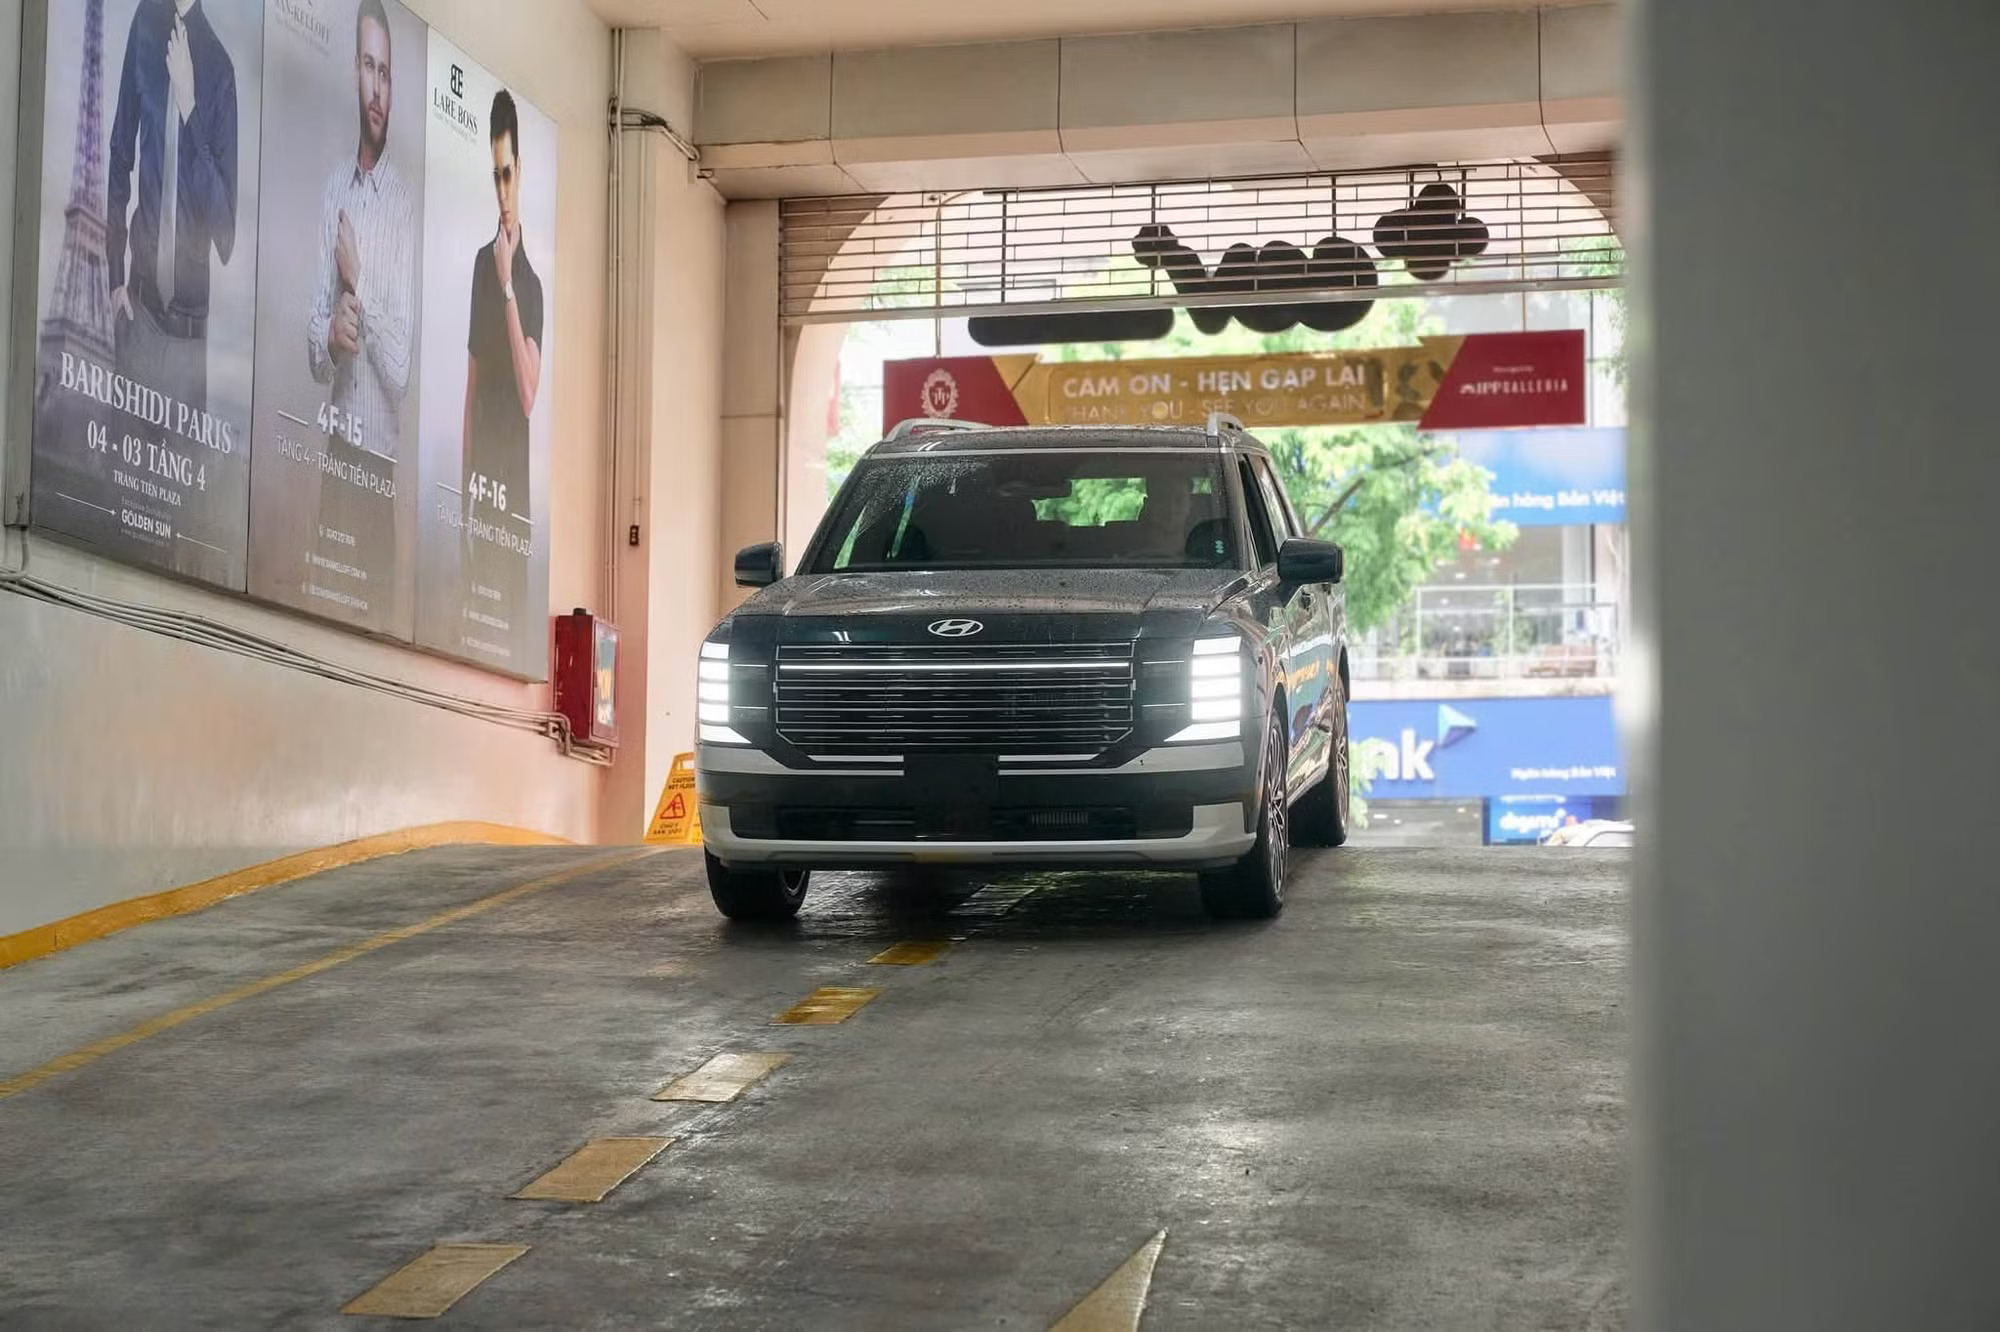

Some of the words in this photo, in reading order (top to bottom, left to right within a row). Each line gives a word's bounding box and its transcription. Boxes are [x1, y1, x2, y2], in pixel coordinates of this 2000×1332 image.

[458, 105, 478, 136] BOSS
[1325, 364, 1365, 390] LẠI
[60, 351, 172, 430] BARISHIDI
[176, 401, 232, 454] PARIS
[317, 401, 363, 446] 4F-15
[87, 419, 107, 454] 04
[122, 433, 142, 467] 03
[196, 463, 206, 491] 4
[159, 486, 181, 507] PLAZA
[370, 473, 397, 500] PLAZA
[468, 471, 507, 512] 4F-16
[155, 520, 171, 539] SUN
[1352, 728, 1435, 780] nk
